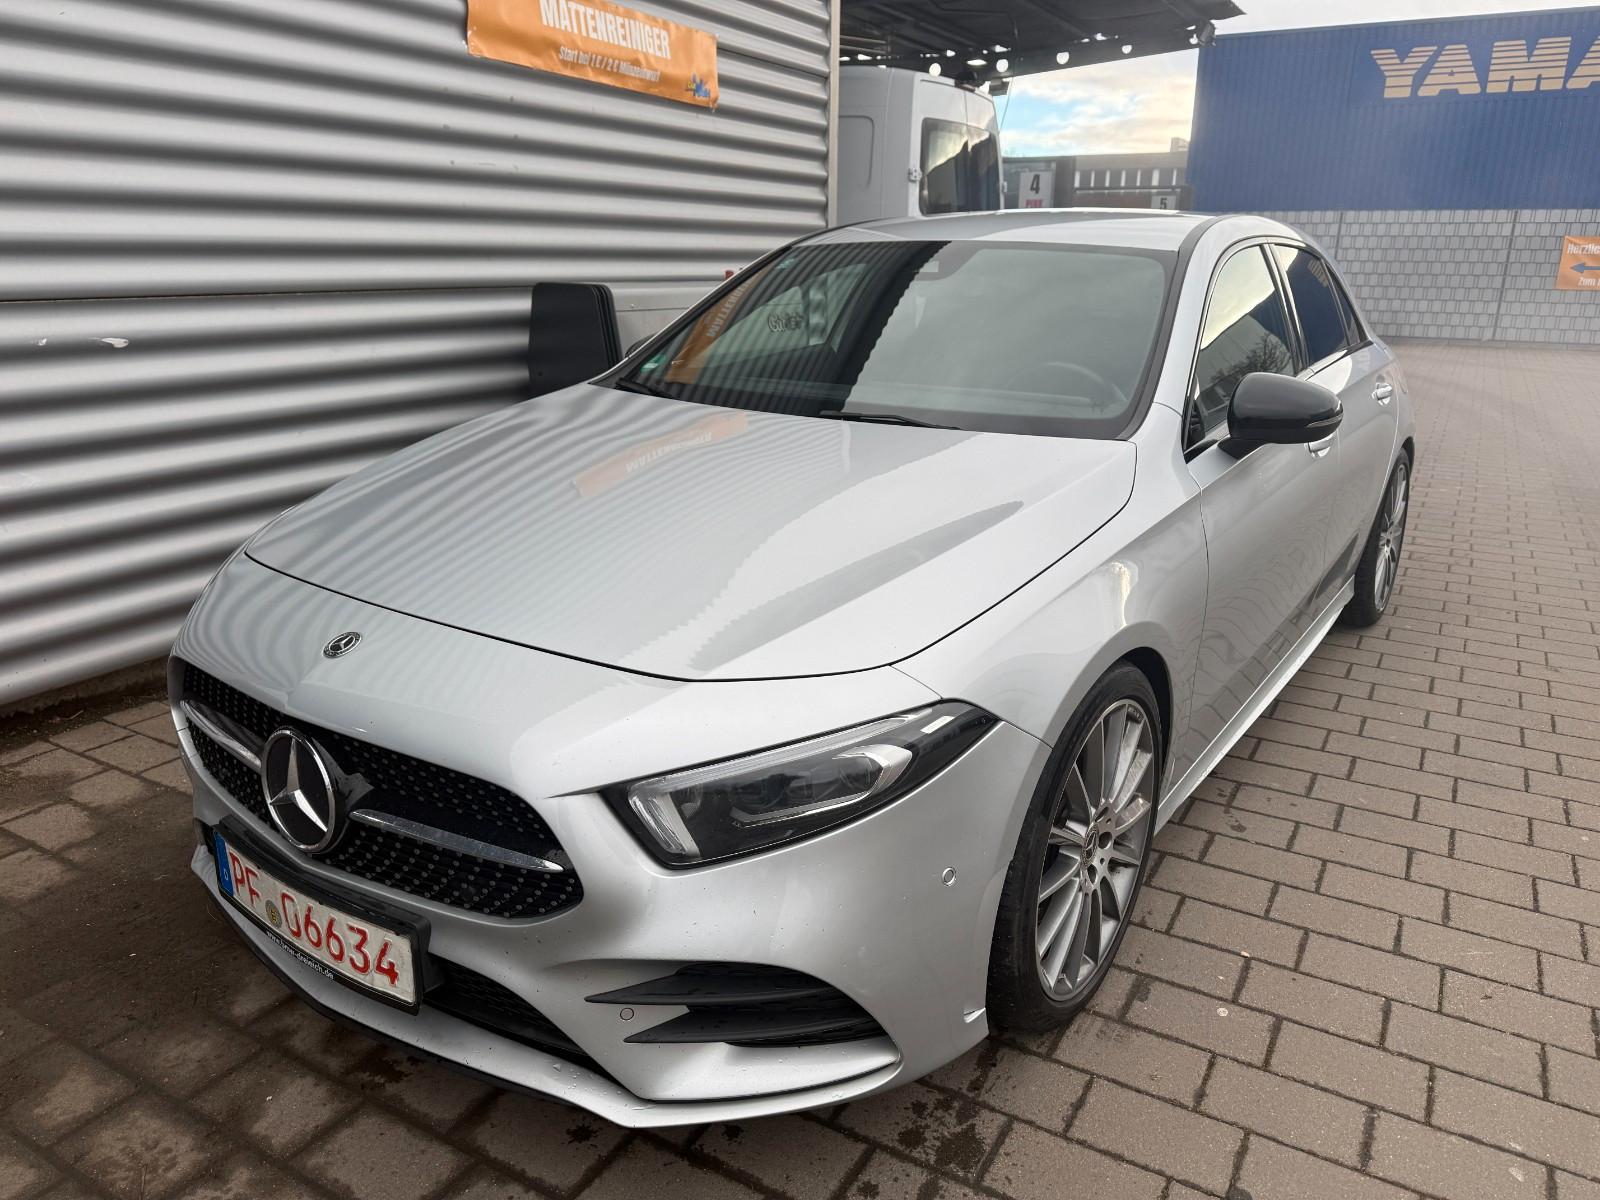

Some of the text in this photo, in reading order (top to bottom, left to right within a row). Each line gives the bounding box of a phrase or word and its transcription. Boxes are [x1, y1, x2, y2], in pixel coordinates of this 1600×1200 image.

[540, 0, 671, 60] MATTENREINIGER
[1029, 173, 1041, 195] 4
[1160, 197, 1168, 209] 5
[229, 851, 400, 987] PF 06634
